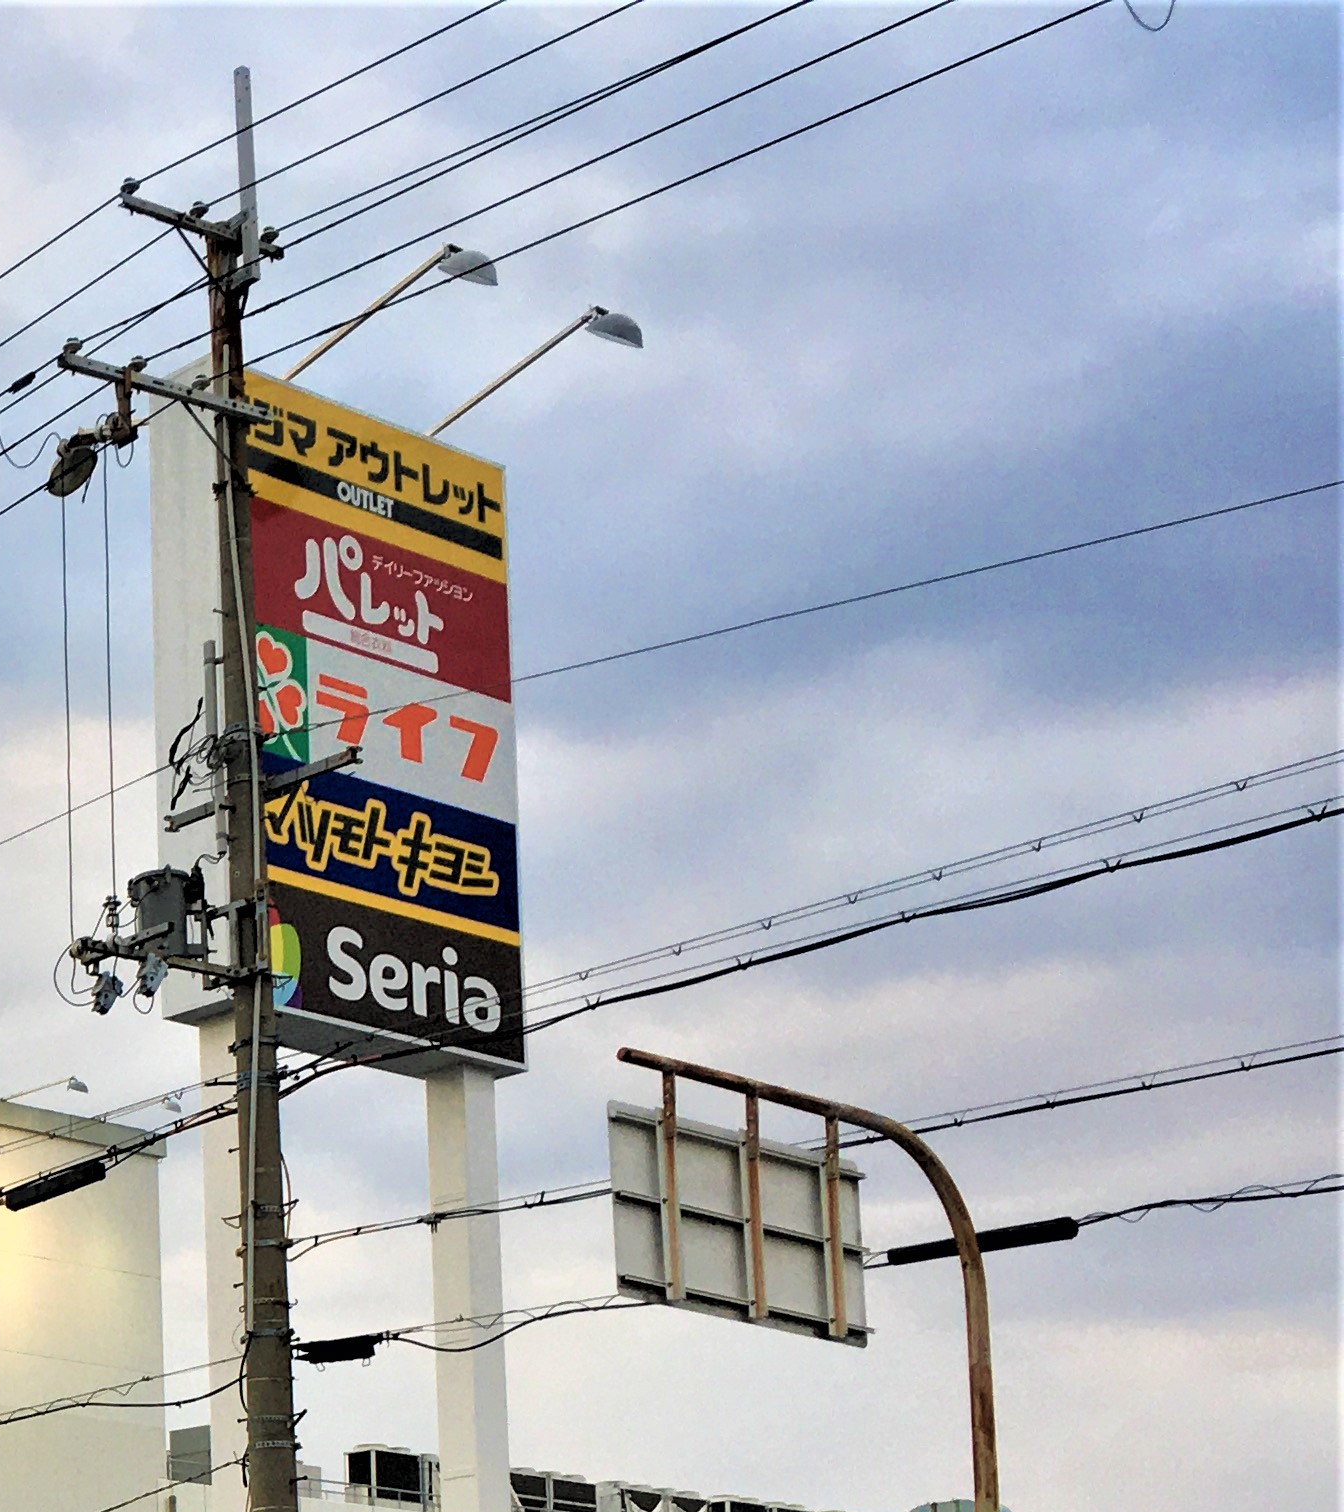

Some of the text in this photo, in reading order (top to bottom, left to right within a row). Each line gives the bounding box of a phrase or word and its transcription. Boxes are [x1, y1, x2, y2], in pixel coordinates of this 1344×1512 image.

[327, 426, 501, 523] アウトレット
[337, 481, 394, 518] OUTLET
[294, 535, 444, 644] パレット
[315, 673, 499, 783] ライフ
[326, 926, 502, 1033] Seria
